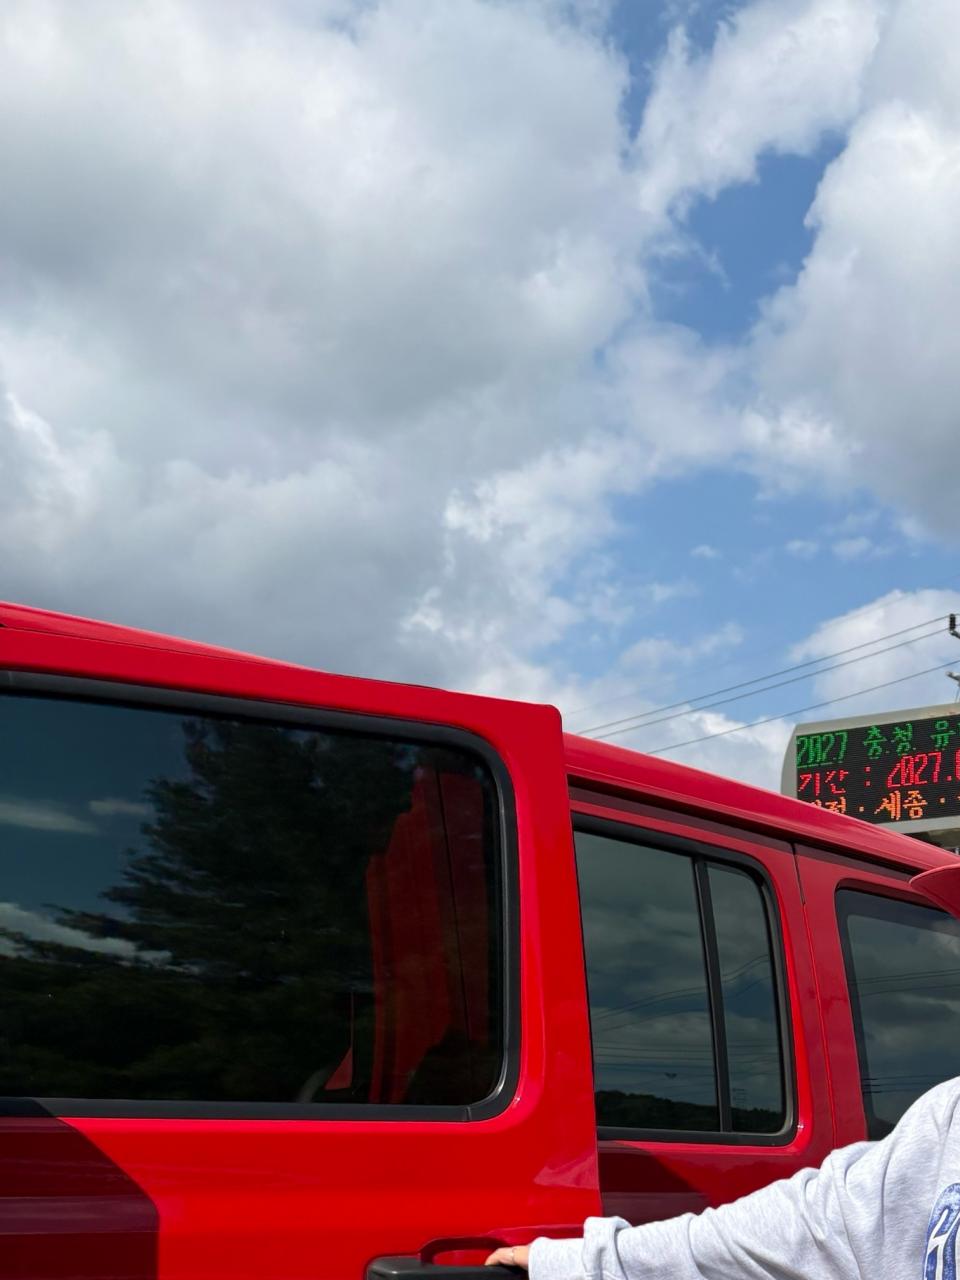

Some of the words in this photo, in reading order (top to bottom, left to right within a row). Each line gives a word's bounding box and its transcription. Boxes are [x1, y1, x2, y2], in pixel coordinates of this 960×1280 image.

[796, 731, 848, 768] 2027
[863, 724, 914, 759] 충청
[798, 769, 849, 797] 기간
